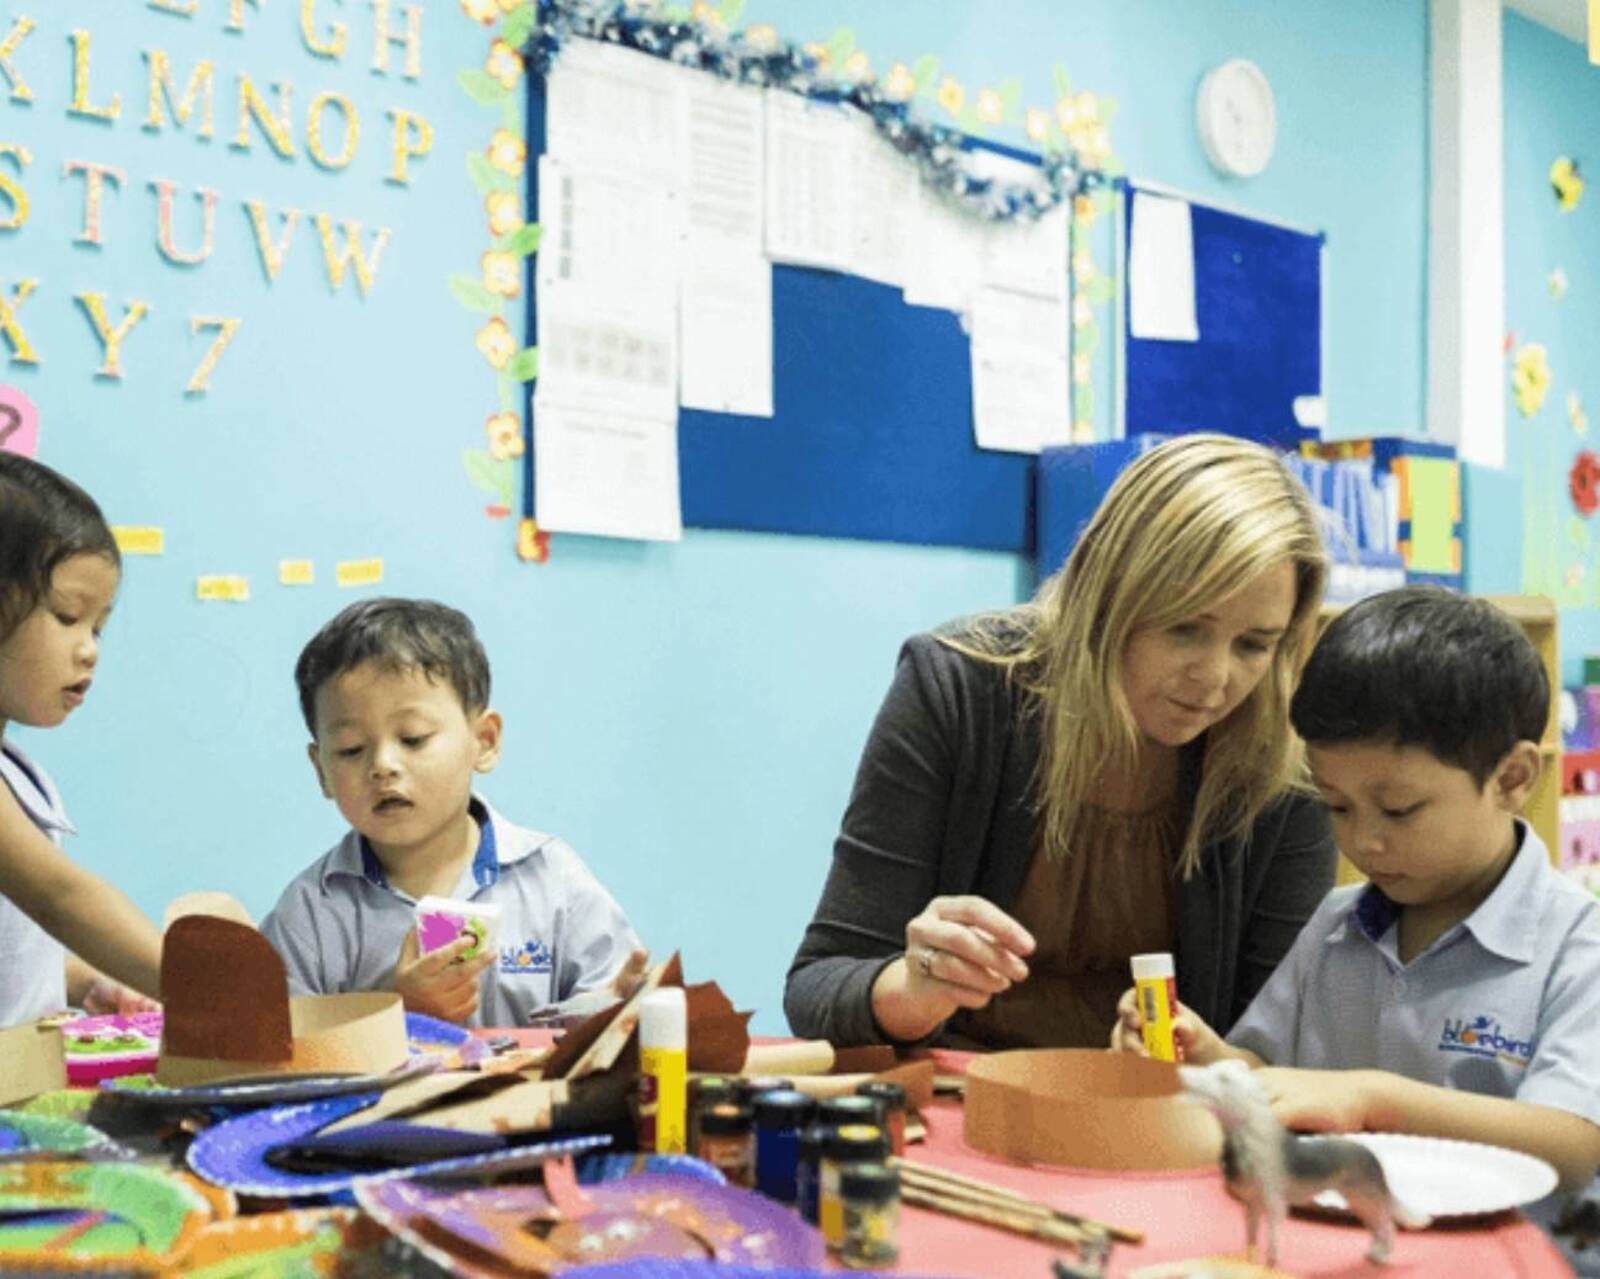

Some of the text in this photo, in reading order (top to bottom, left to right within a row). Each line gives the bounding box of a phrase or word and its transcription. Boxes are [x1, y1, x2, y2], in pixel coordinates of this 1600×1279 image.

[67, 29, 121, 122] L
[145, 48, 215, 140] M
[234, 74, 296, 158] N
[387, 107, 434, 184] P
[62, 160, 127, 248] T
[149, 181, 218, 267] U
[243, 199, 302, 283] V
[313, 212, 392, 297] W
[75, 291, 150, 379] Y
